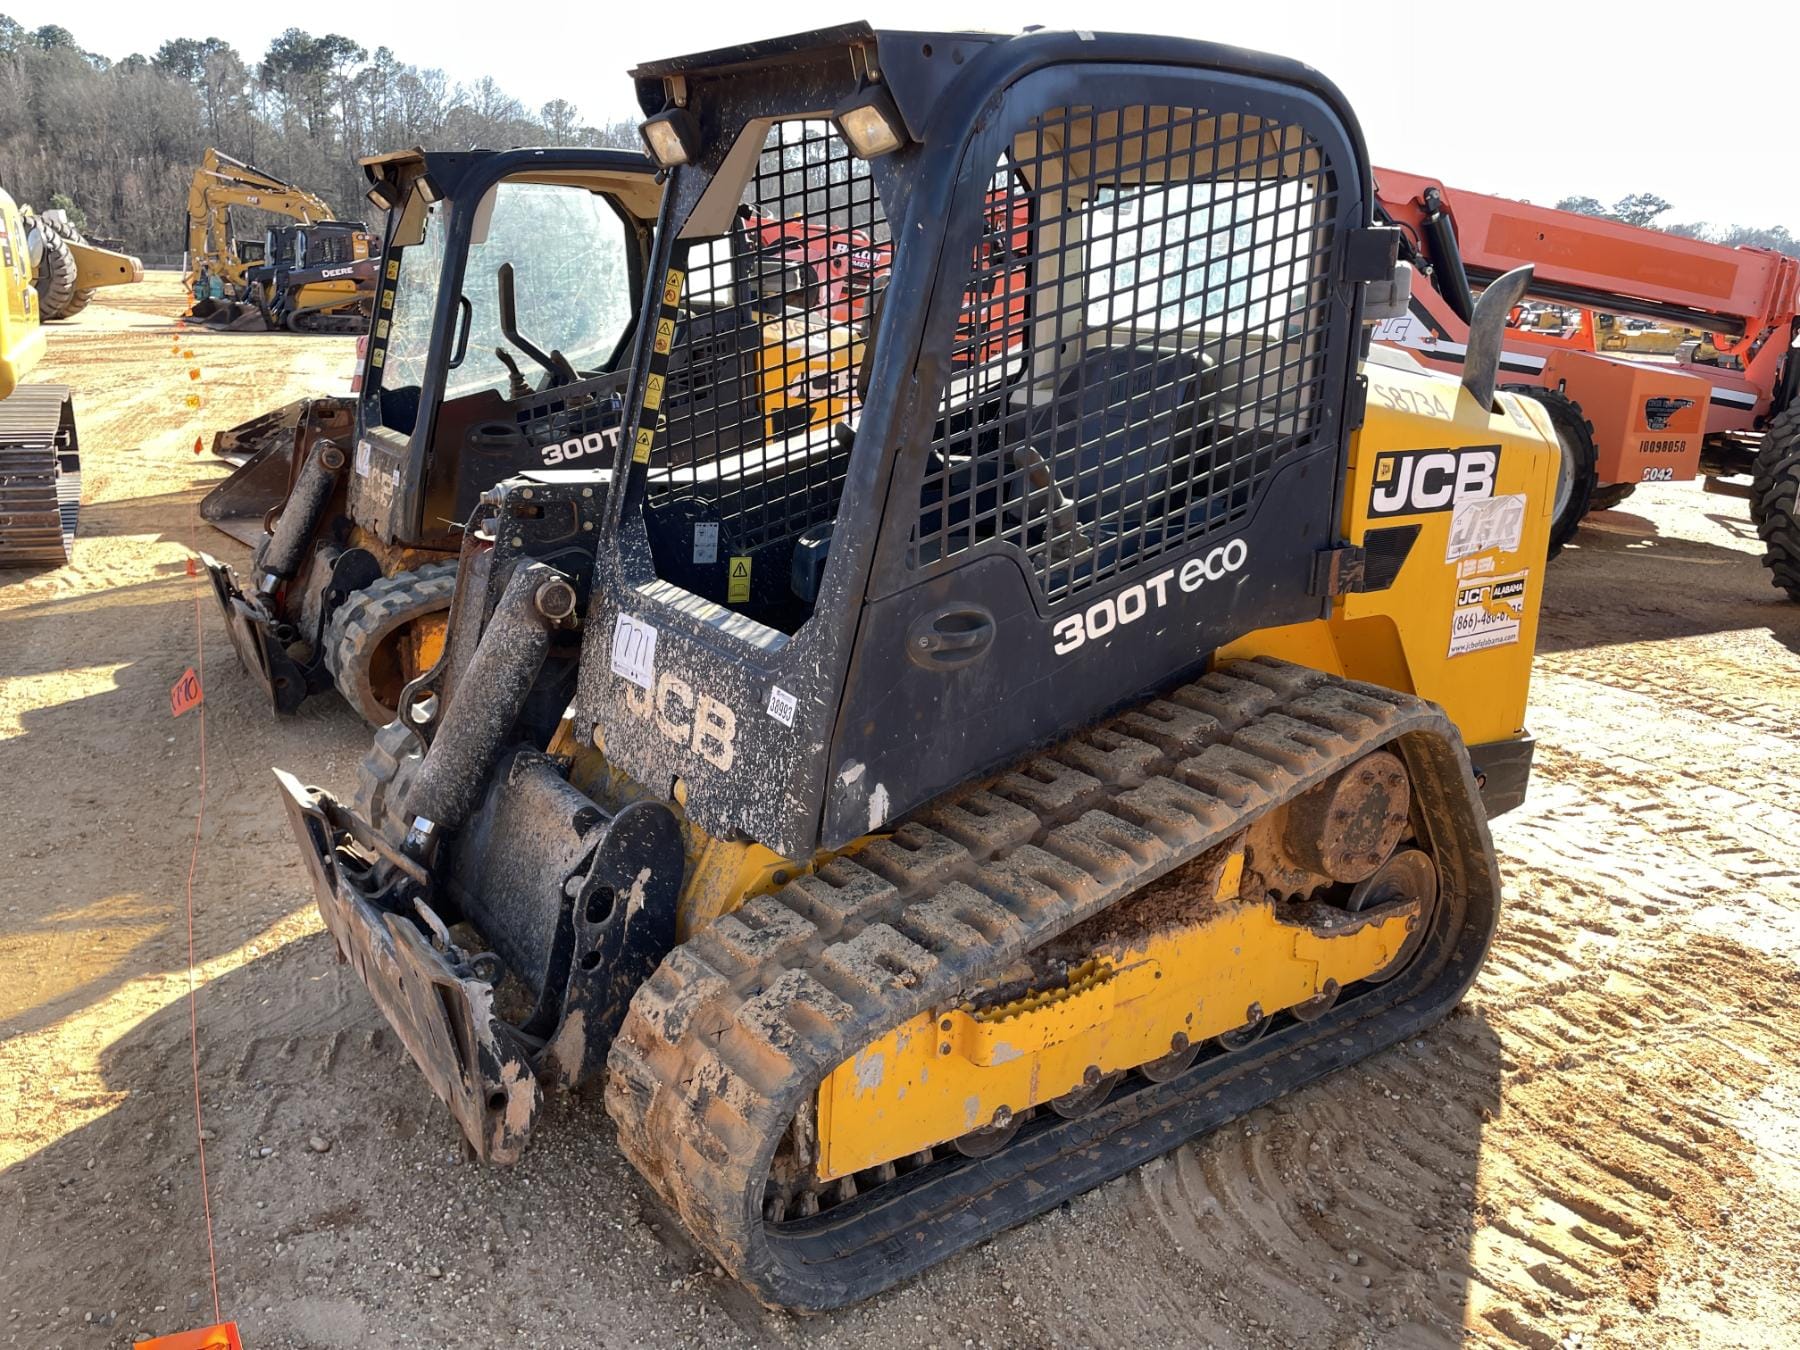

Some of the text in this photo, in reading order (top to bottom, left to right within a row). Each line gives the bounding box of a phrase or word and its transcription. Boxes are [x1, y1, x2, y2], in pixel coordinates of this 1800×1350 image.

[322, 267, 353, 277] DEERE
[541, 426, 621, 465] 300T
[1373, 452, 1496, 512] JCB
[1053, 538, 1247, 655] 300T eco
[1493, 583, 1523, 597] ALABAMA
